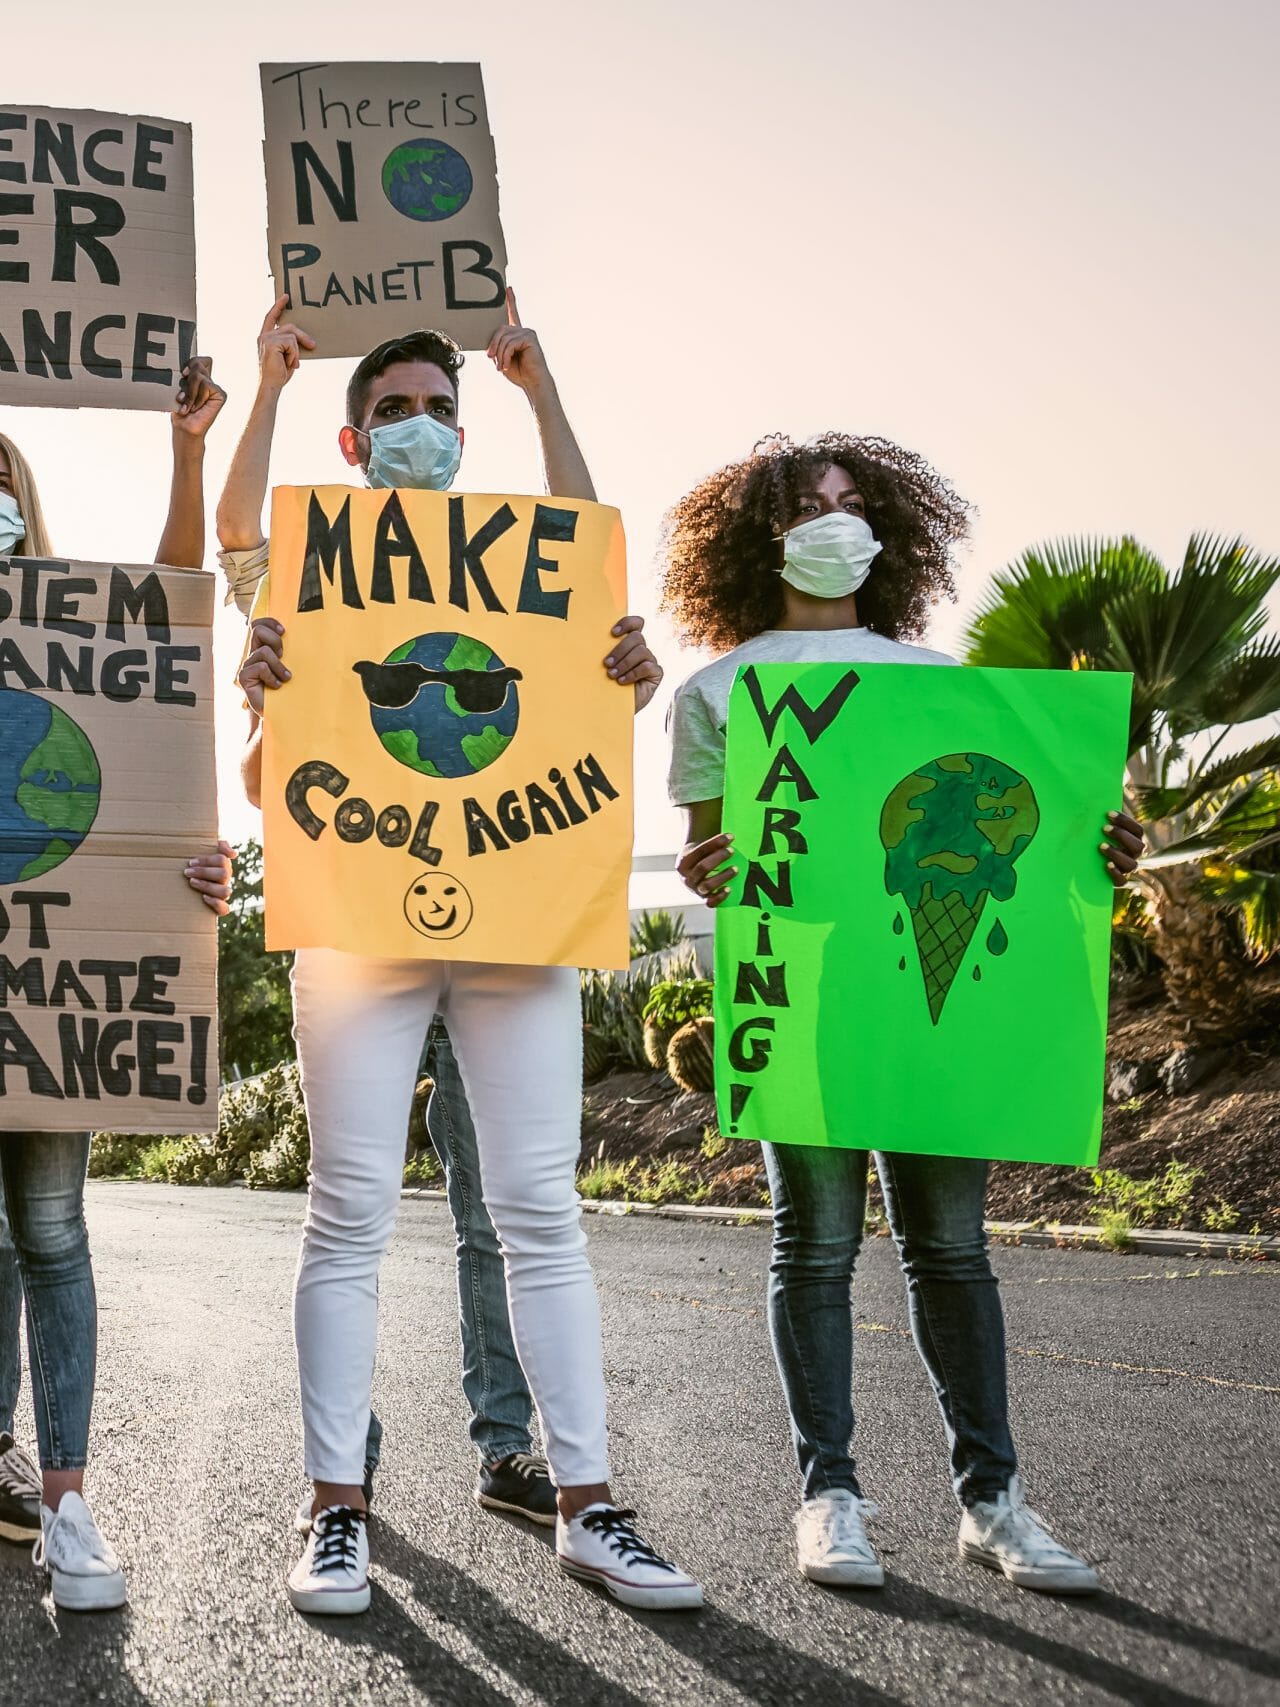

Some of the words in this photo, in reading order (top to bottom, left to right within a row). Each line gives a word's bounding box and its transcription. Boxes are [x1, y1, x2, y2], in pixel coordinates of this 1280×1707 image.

[271, 63, 434, 130] There
[440, 92, 478, 128] is
[441, 239, 507, 310] B
[296, 488, 579, 621] MAKE
[284, 759, 444, 867] COOL
